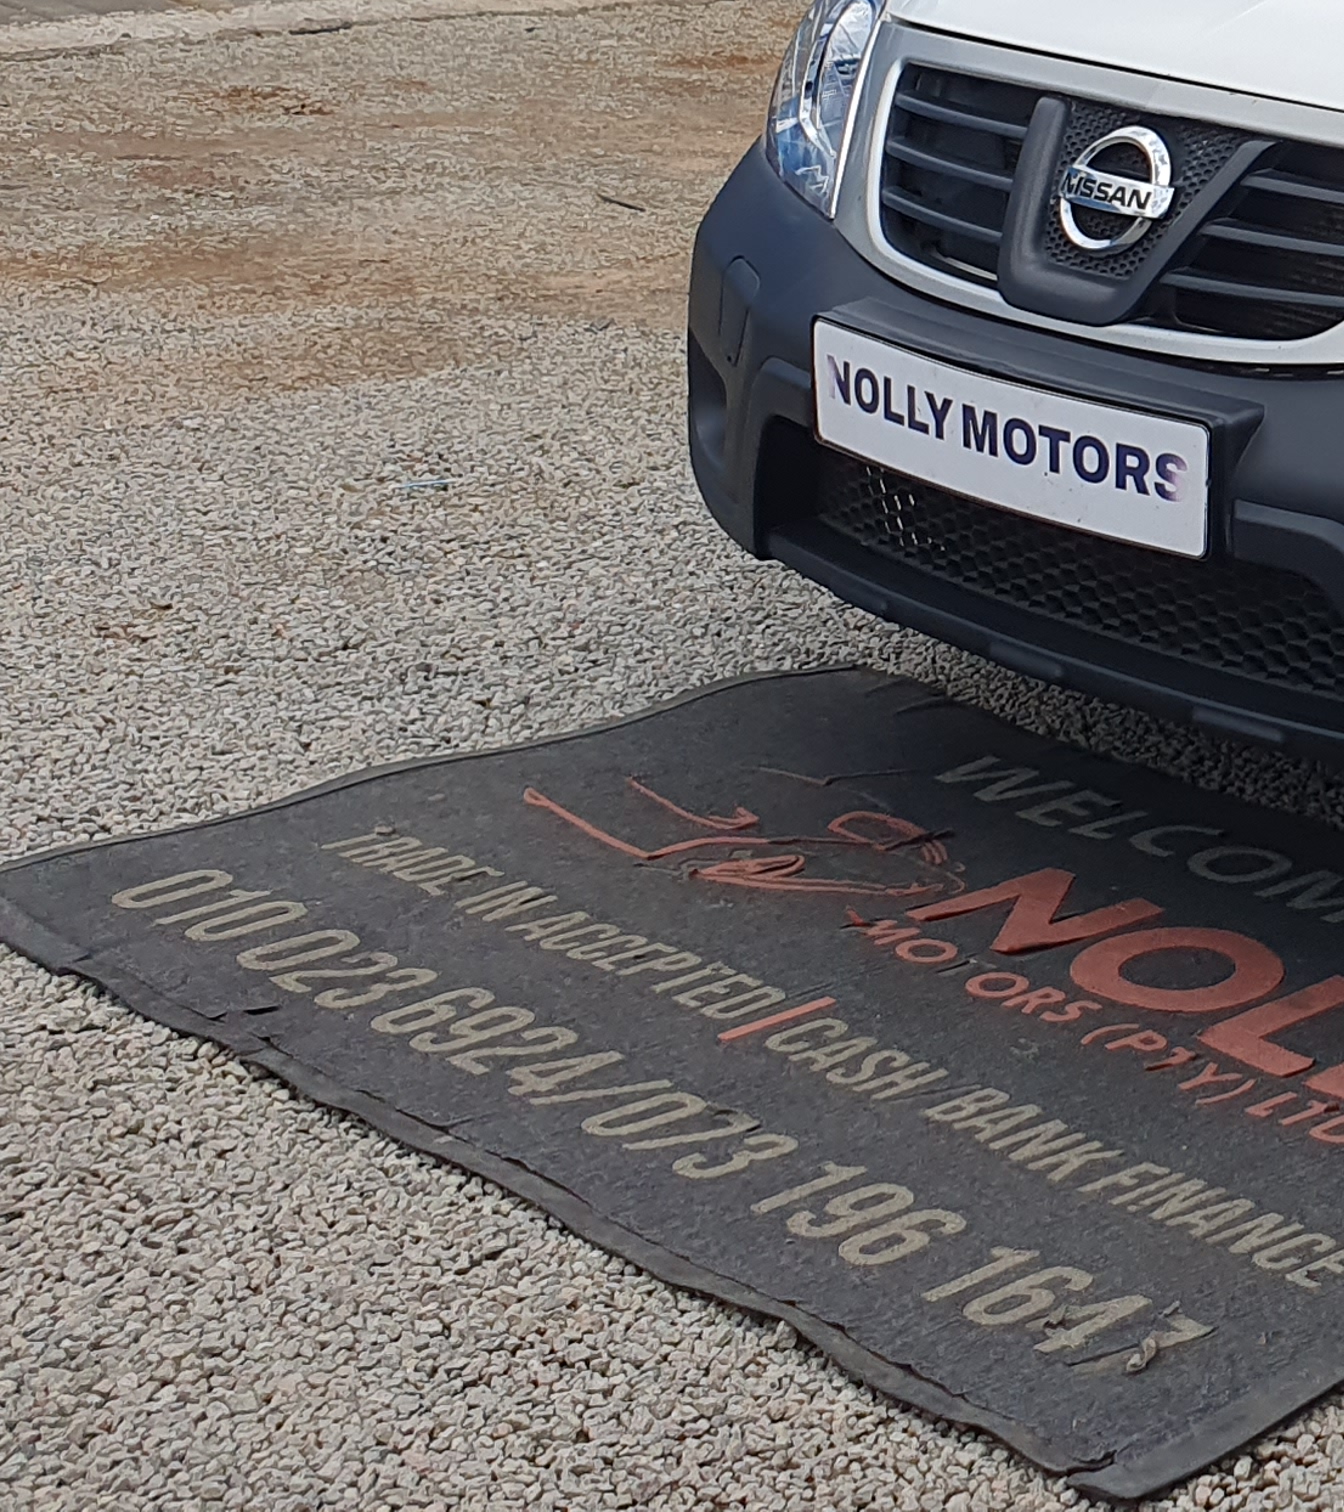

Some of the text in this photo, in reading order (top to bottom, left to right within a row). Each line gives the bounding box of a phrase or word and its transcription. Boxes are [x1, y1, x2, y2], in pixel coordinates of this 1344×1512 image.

[1061, 170, 1153, 210] NISSAN
[826, 354, 1189, 503] NOLLY MOTORS
[320, 828, 505, 897] TRADE
[454, 880, 559, 923] IN
[505, 910, 789, 1021] ACCEPTED
[111, 868, 309, 943] 010
[236, 928, 439, 1010] 023
[749, 1159, 968, 1266] 196
[765, 1017, 949, 1103] CASH
